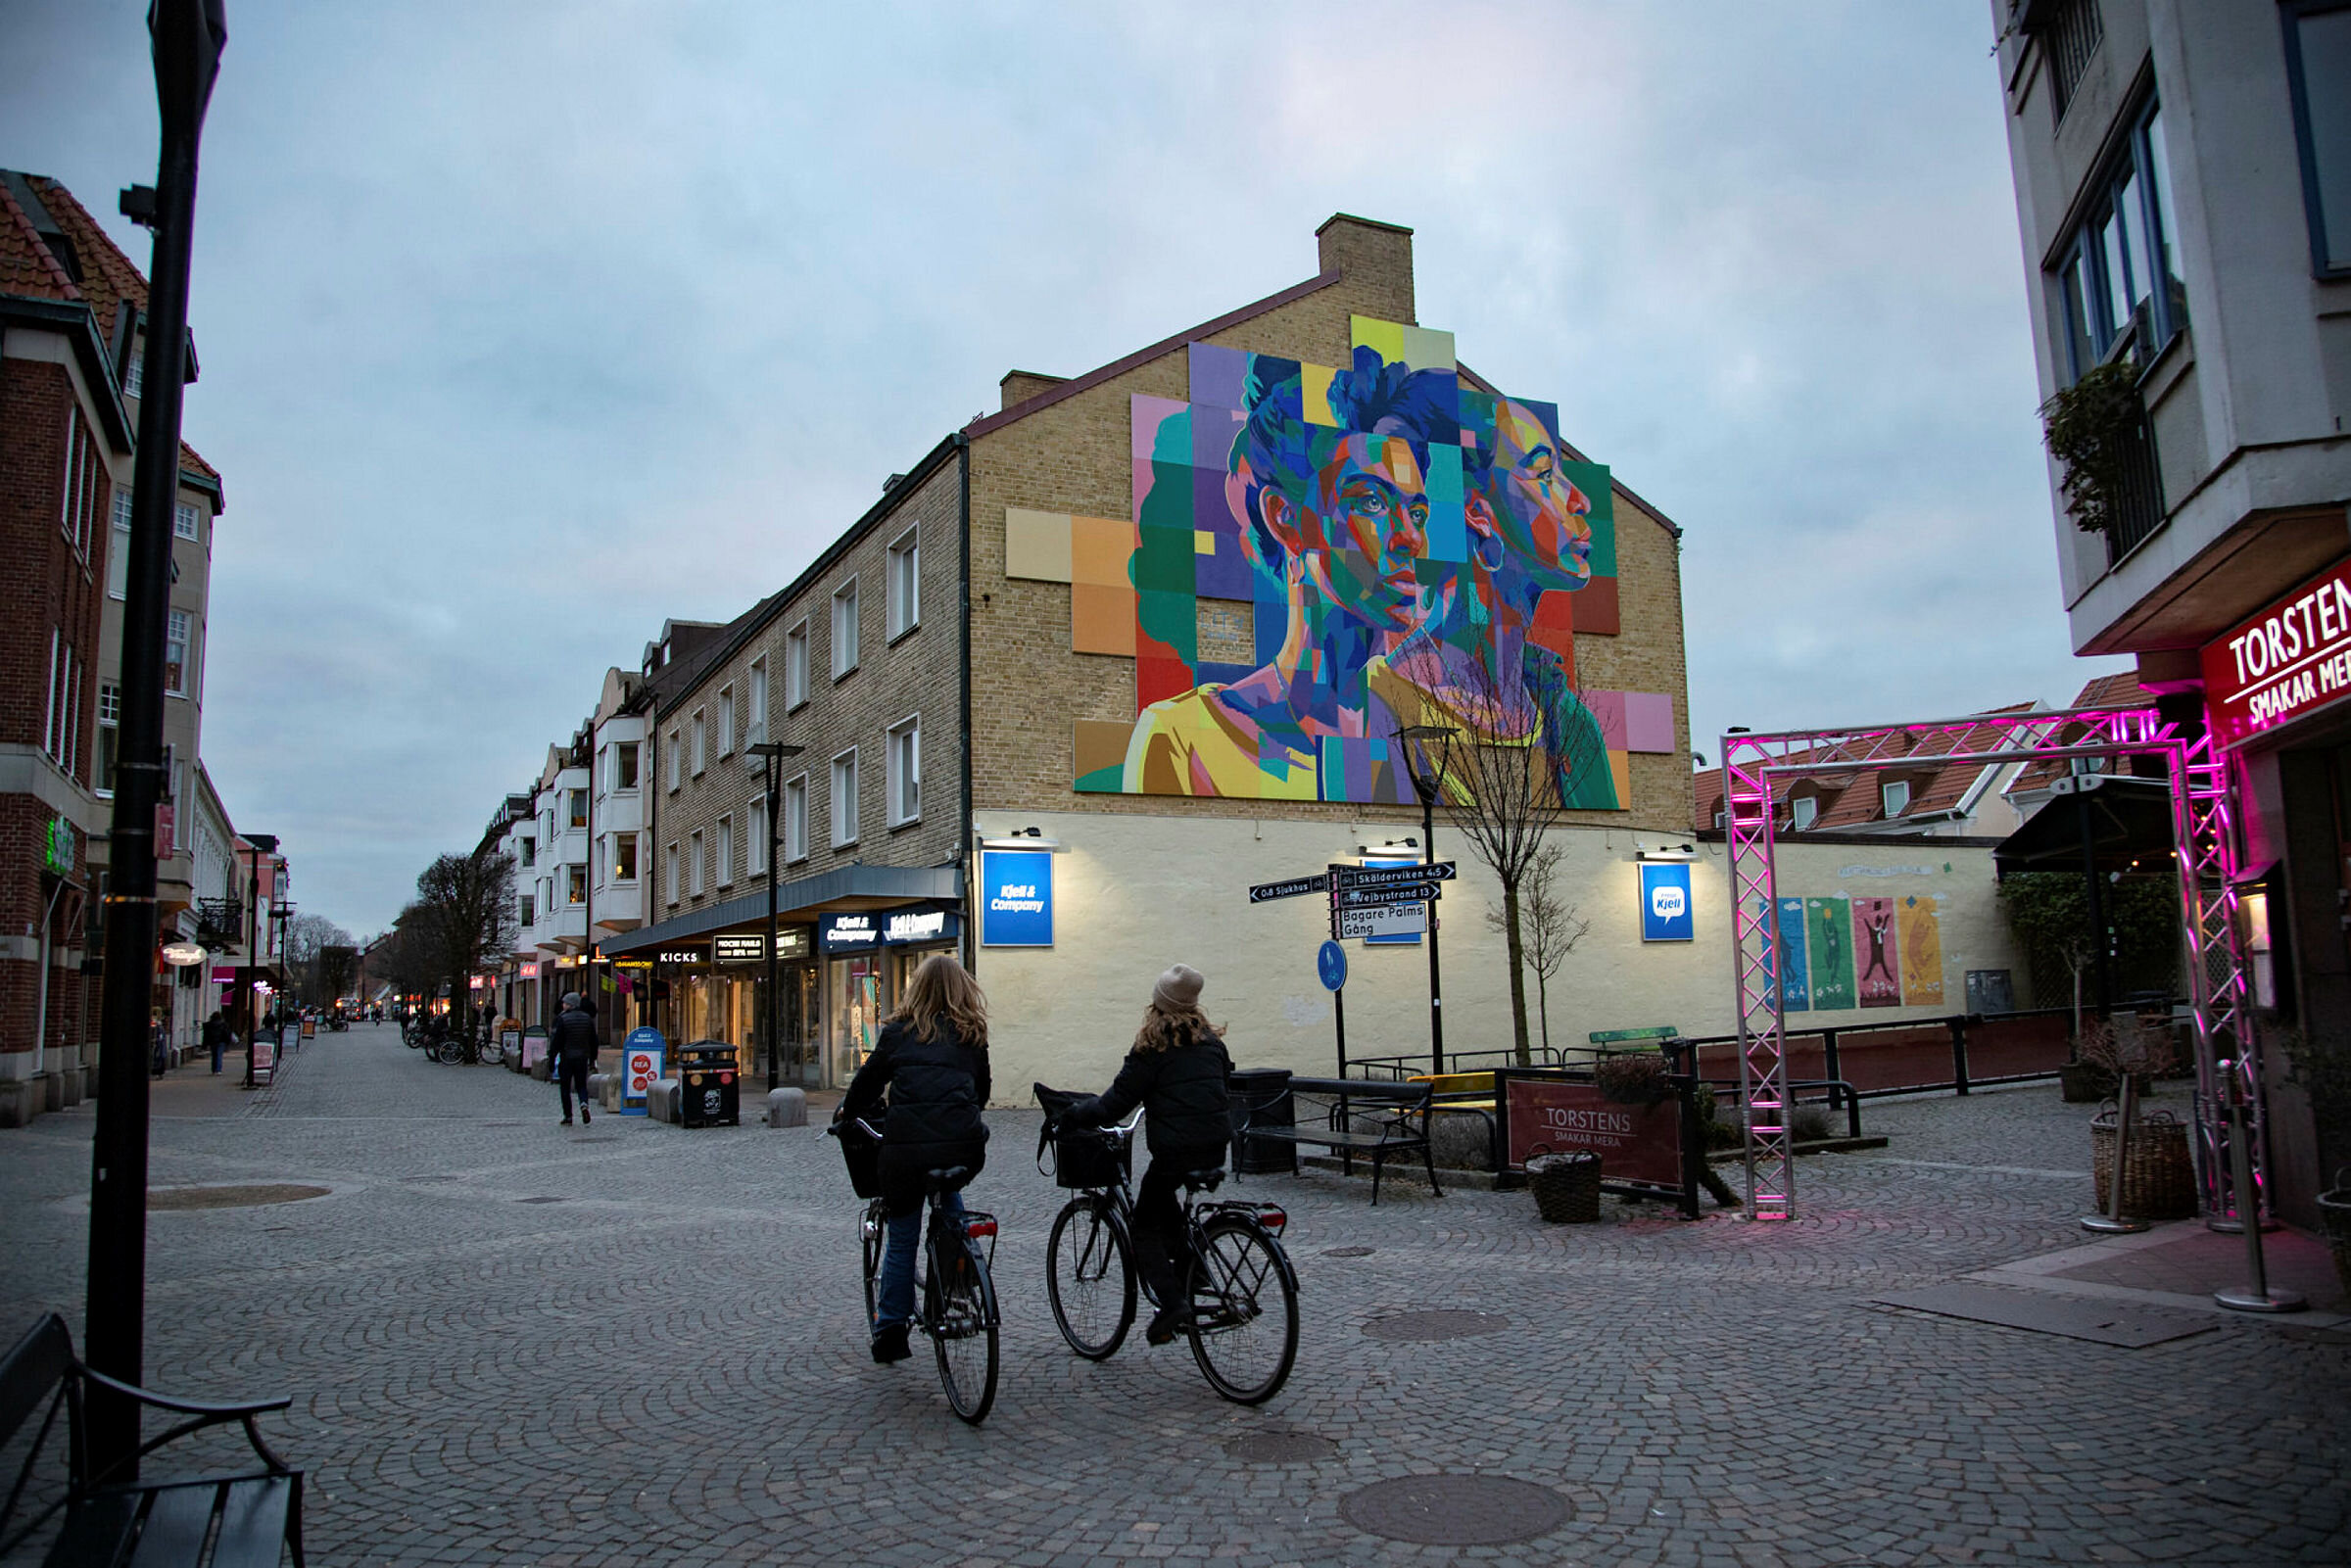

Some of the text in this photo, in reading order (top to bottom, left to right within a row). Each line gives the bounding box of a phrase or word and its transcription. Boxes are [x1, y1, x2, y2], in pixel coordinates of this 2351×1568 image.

[2249, 671, 2318, 725] SMAKAR
[1358, 870, 1423, 883] Skälderviken
[1000, 884, 1035, 899] Kjell &
[1275, 883, 1309, 895] Sjukhus
[1359, 887, 1429, 903] Vejbystrand 13
[991, 898, 1044, 913] Company
[1656, 898, 1681, 910] Kjell
[1343, 905, 1423, 923] Bagare Palms
[1344, 925, 1373, 935] Gång
[659, 952, 698, 963] KICKS
[1546, 1108, 1631, 1132] TORSTENS
[1555, 1131, 1621, 1148] SMAKAR MERA
